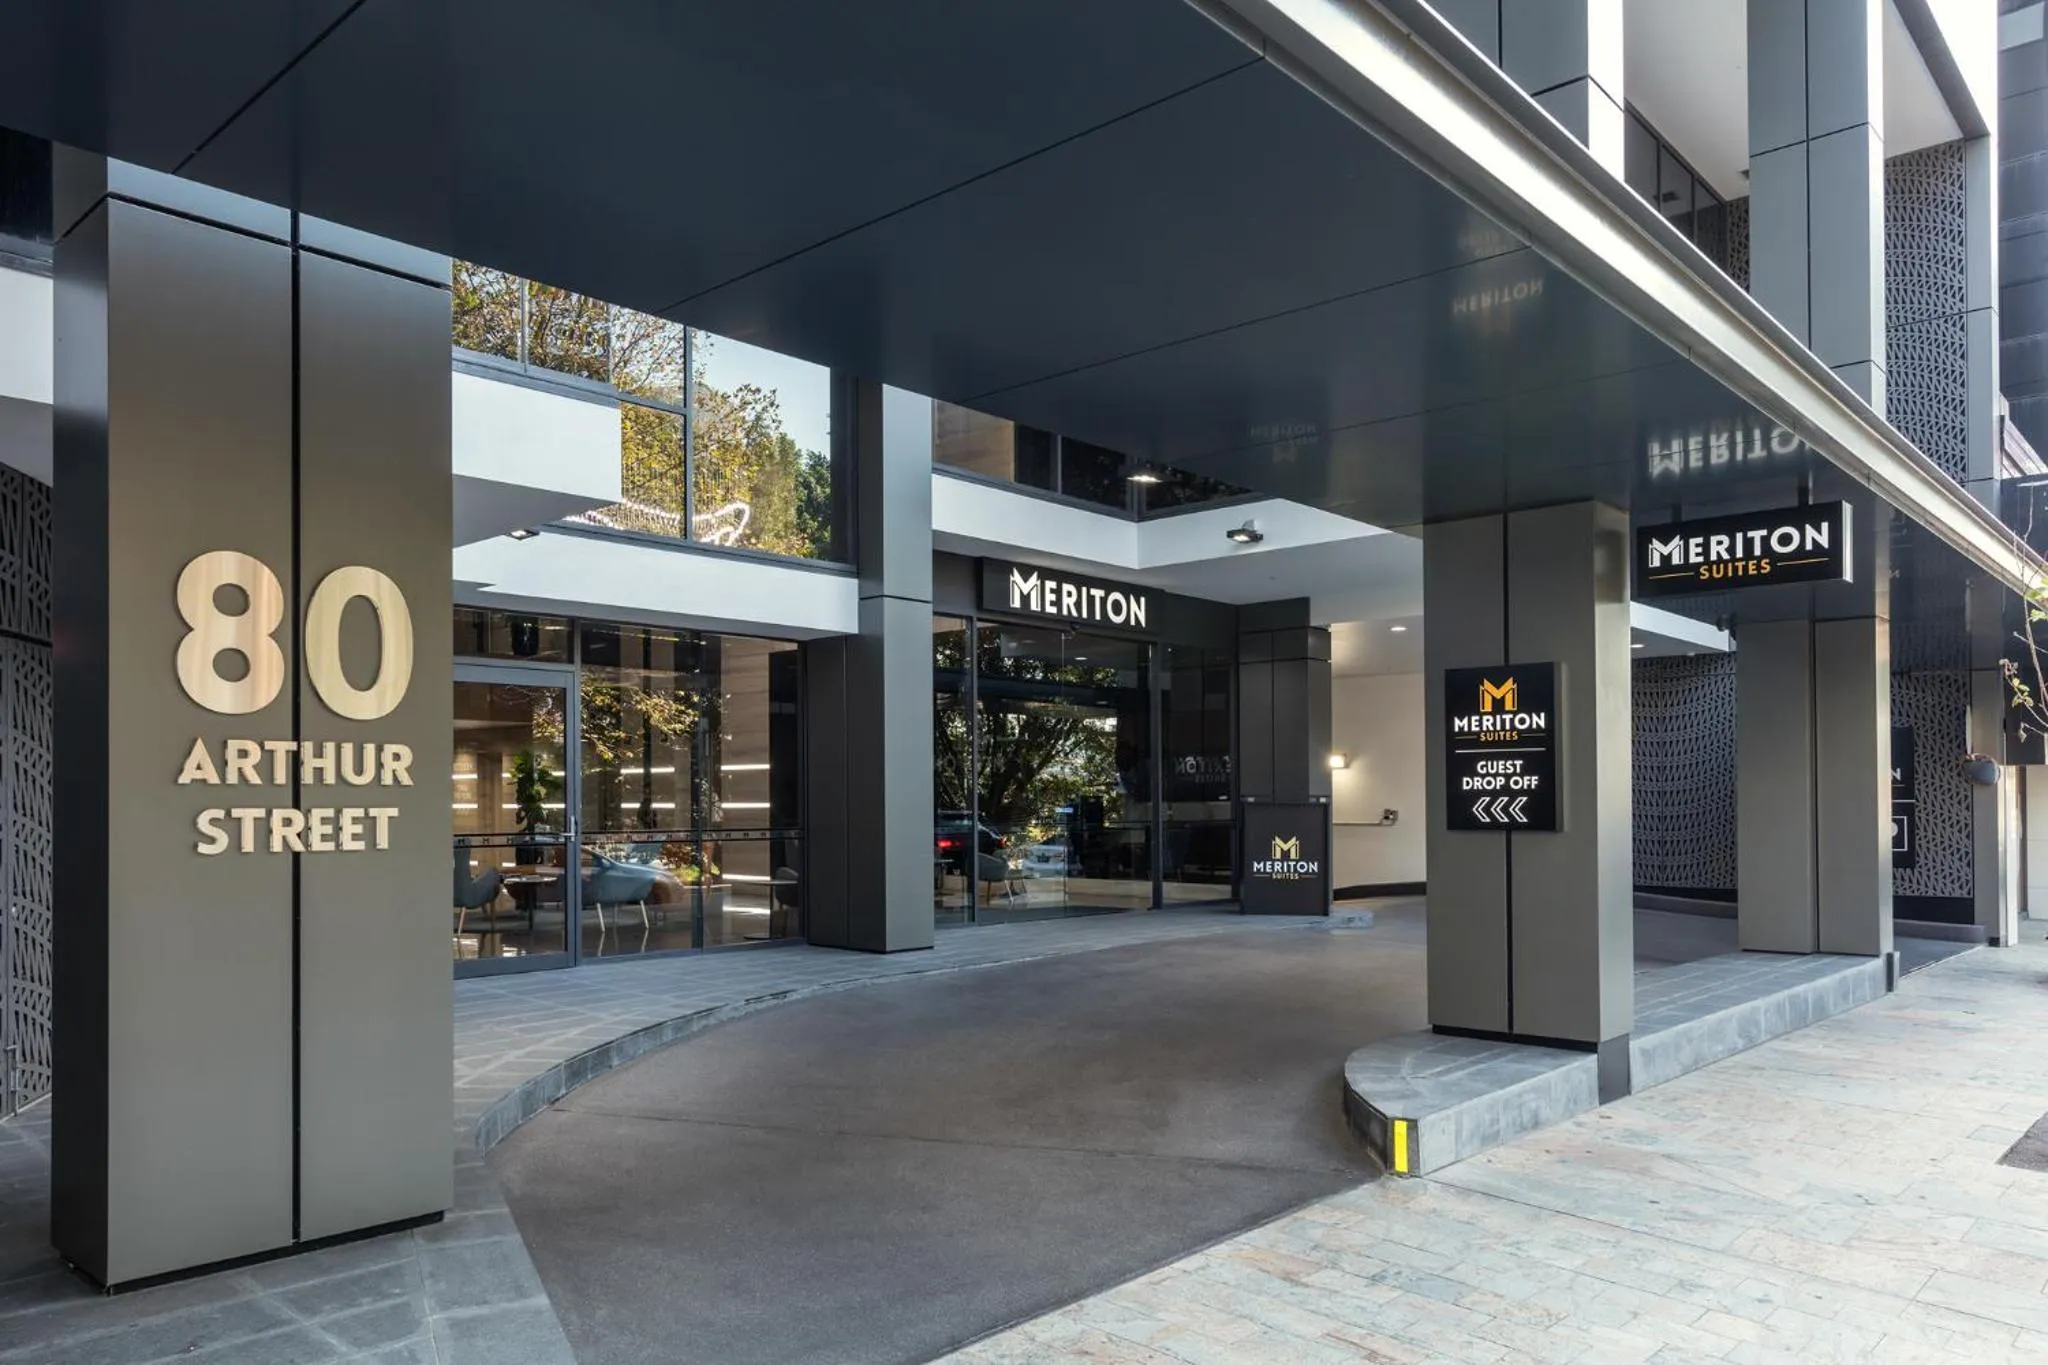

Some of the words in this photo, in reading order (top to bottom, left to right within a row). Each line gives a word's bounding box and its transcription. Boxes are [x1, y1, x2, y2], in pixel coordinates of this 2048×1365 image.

[1648, 521, 1829, 568] MERITON
[1699, 558, 1771, 580] SUITES
[1009, 566, 1147, 628] MERITON
[176, 550, 414, 721] 80
[1453, 712, 1546, 732] MERITON
[1479, 730, 1519, 742] SUITES
[177, 736, 415, 786] ARTHUR
[1476, 760, 1524, 774] GUEST
[1461, 776, 1506, 791] DROP
[1509, 776, 1540, 790] OFF
[195, 807, 399, 856] STREET
[1252, 861, 1319, 873] MERITON
